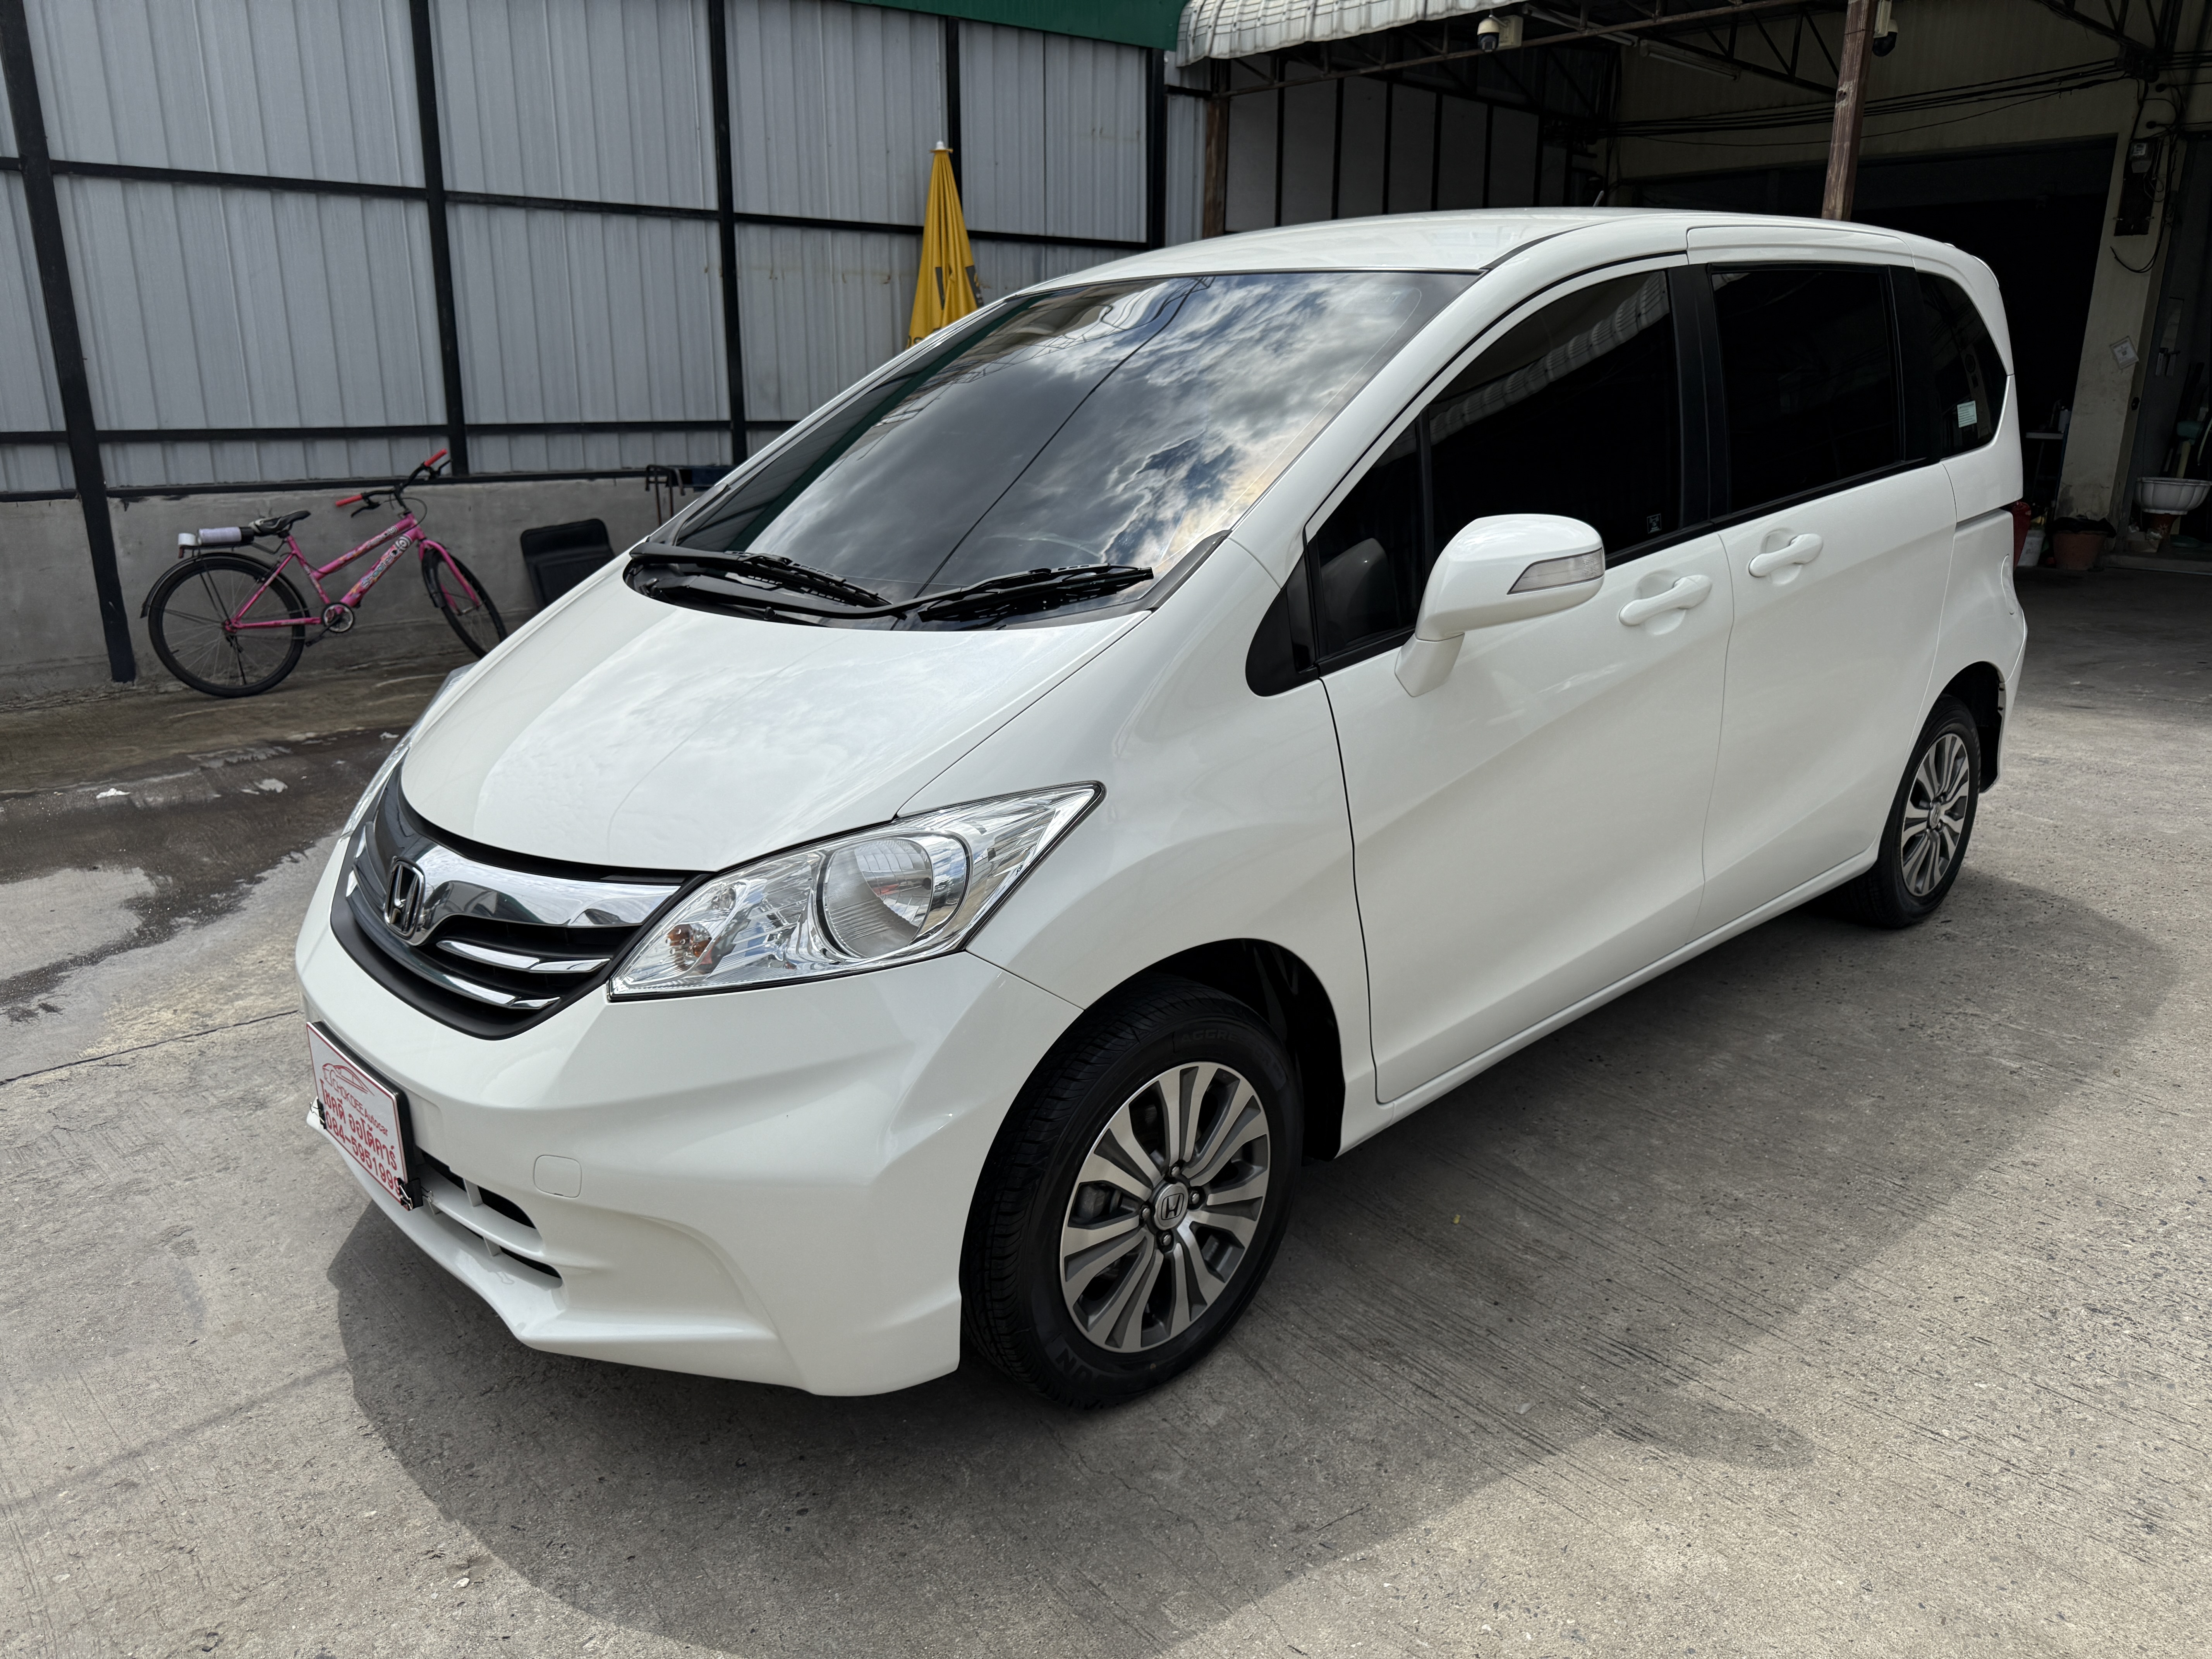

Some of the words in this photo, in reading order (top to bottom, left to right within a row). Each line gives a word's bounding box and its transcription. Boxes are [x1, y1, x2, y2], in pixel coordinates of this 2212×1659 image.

[320, 1078, 346, 1124] โชคดี
[332, 1078, 364, 1116] CHOKDEE
[364, 1108, 388, 1137] Autocar
[326, 1110, 401, 1197] 084-5951999
